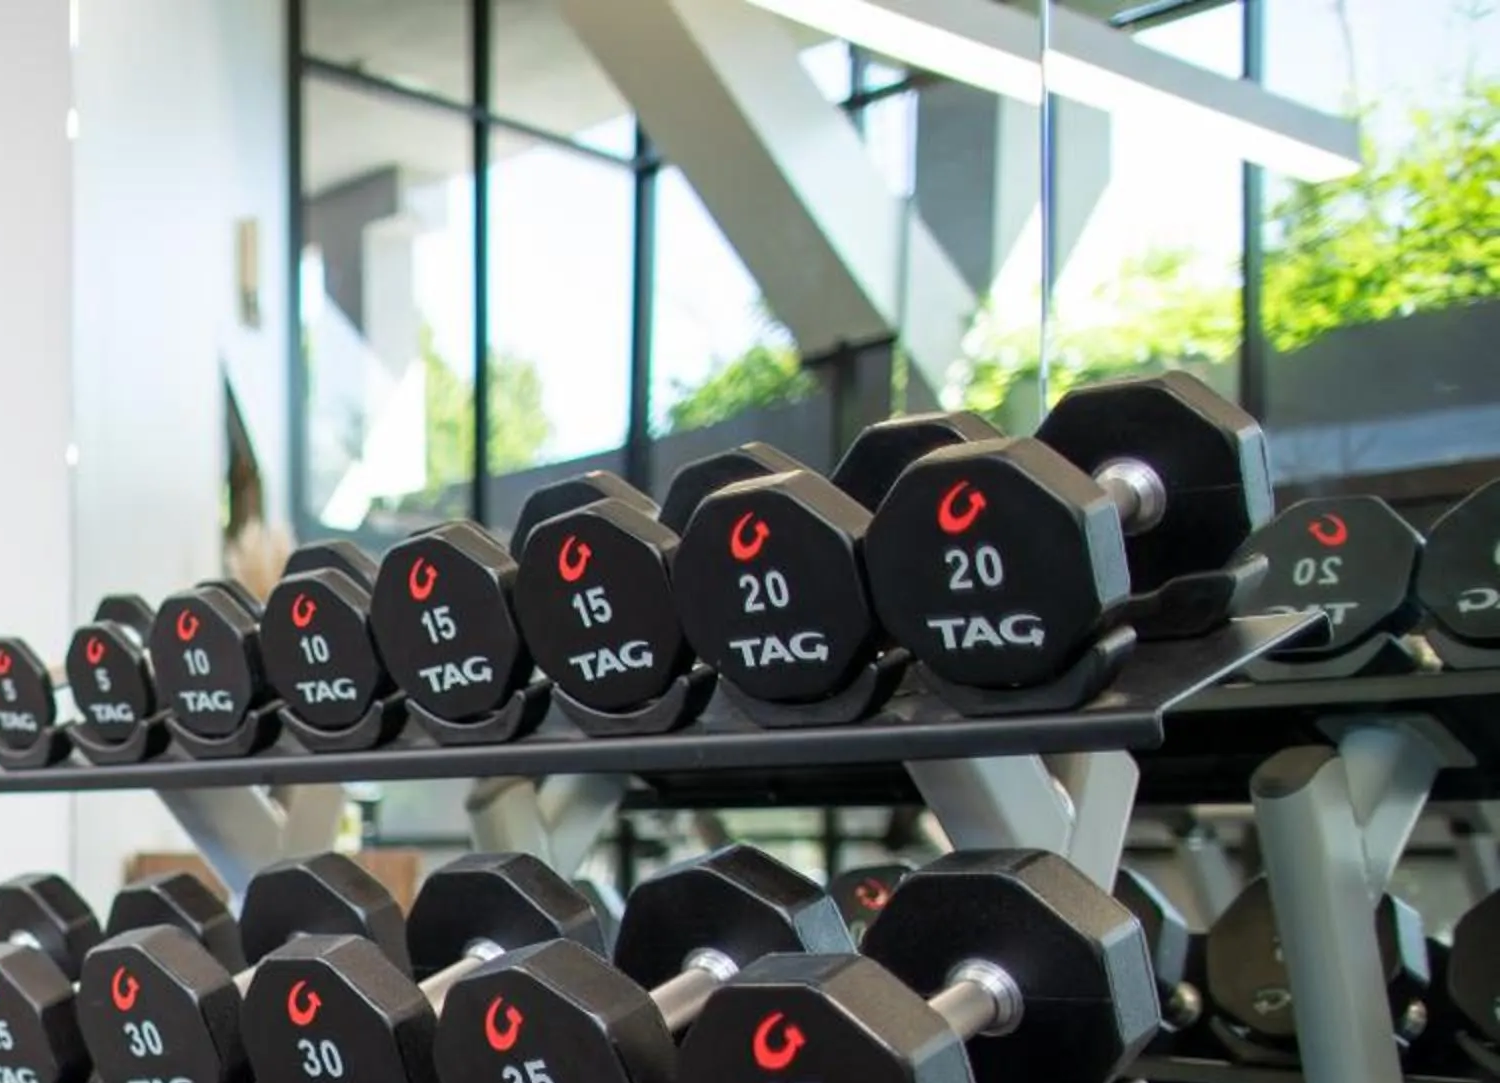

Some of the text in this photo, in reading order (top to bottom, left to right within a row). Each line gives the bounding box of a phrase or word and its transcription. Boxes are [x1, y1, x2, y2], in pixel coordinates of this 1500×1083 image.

[944, 545, 1004, 590] 20
[572, 586, 613, 628] 15
[739, 570, 790, 613] 20
[421, 605, 457, 644] 15
[927, 613, 1045, 650] TAG
[183, 648, 210, 675] 10
[300, 635, 330, 664] 10
[568, 640, 654, 681] TAG
[729, 631, 829, 668] TAG
[296, 677, 357, 703] TAG
[418, 655, 493, 693] TAG
[89, 702, 134, 723] TAG
[179, 690, 234, 712] TAG
[123, 1020, 163, 1057] 30
[298, 1038, 344, 1078] 30
